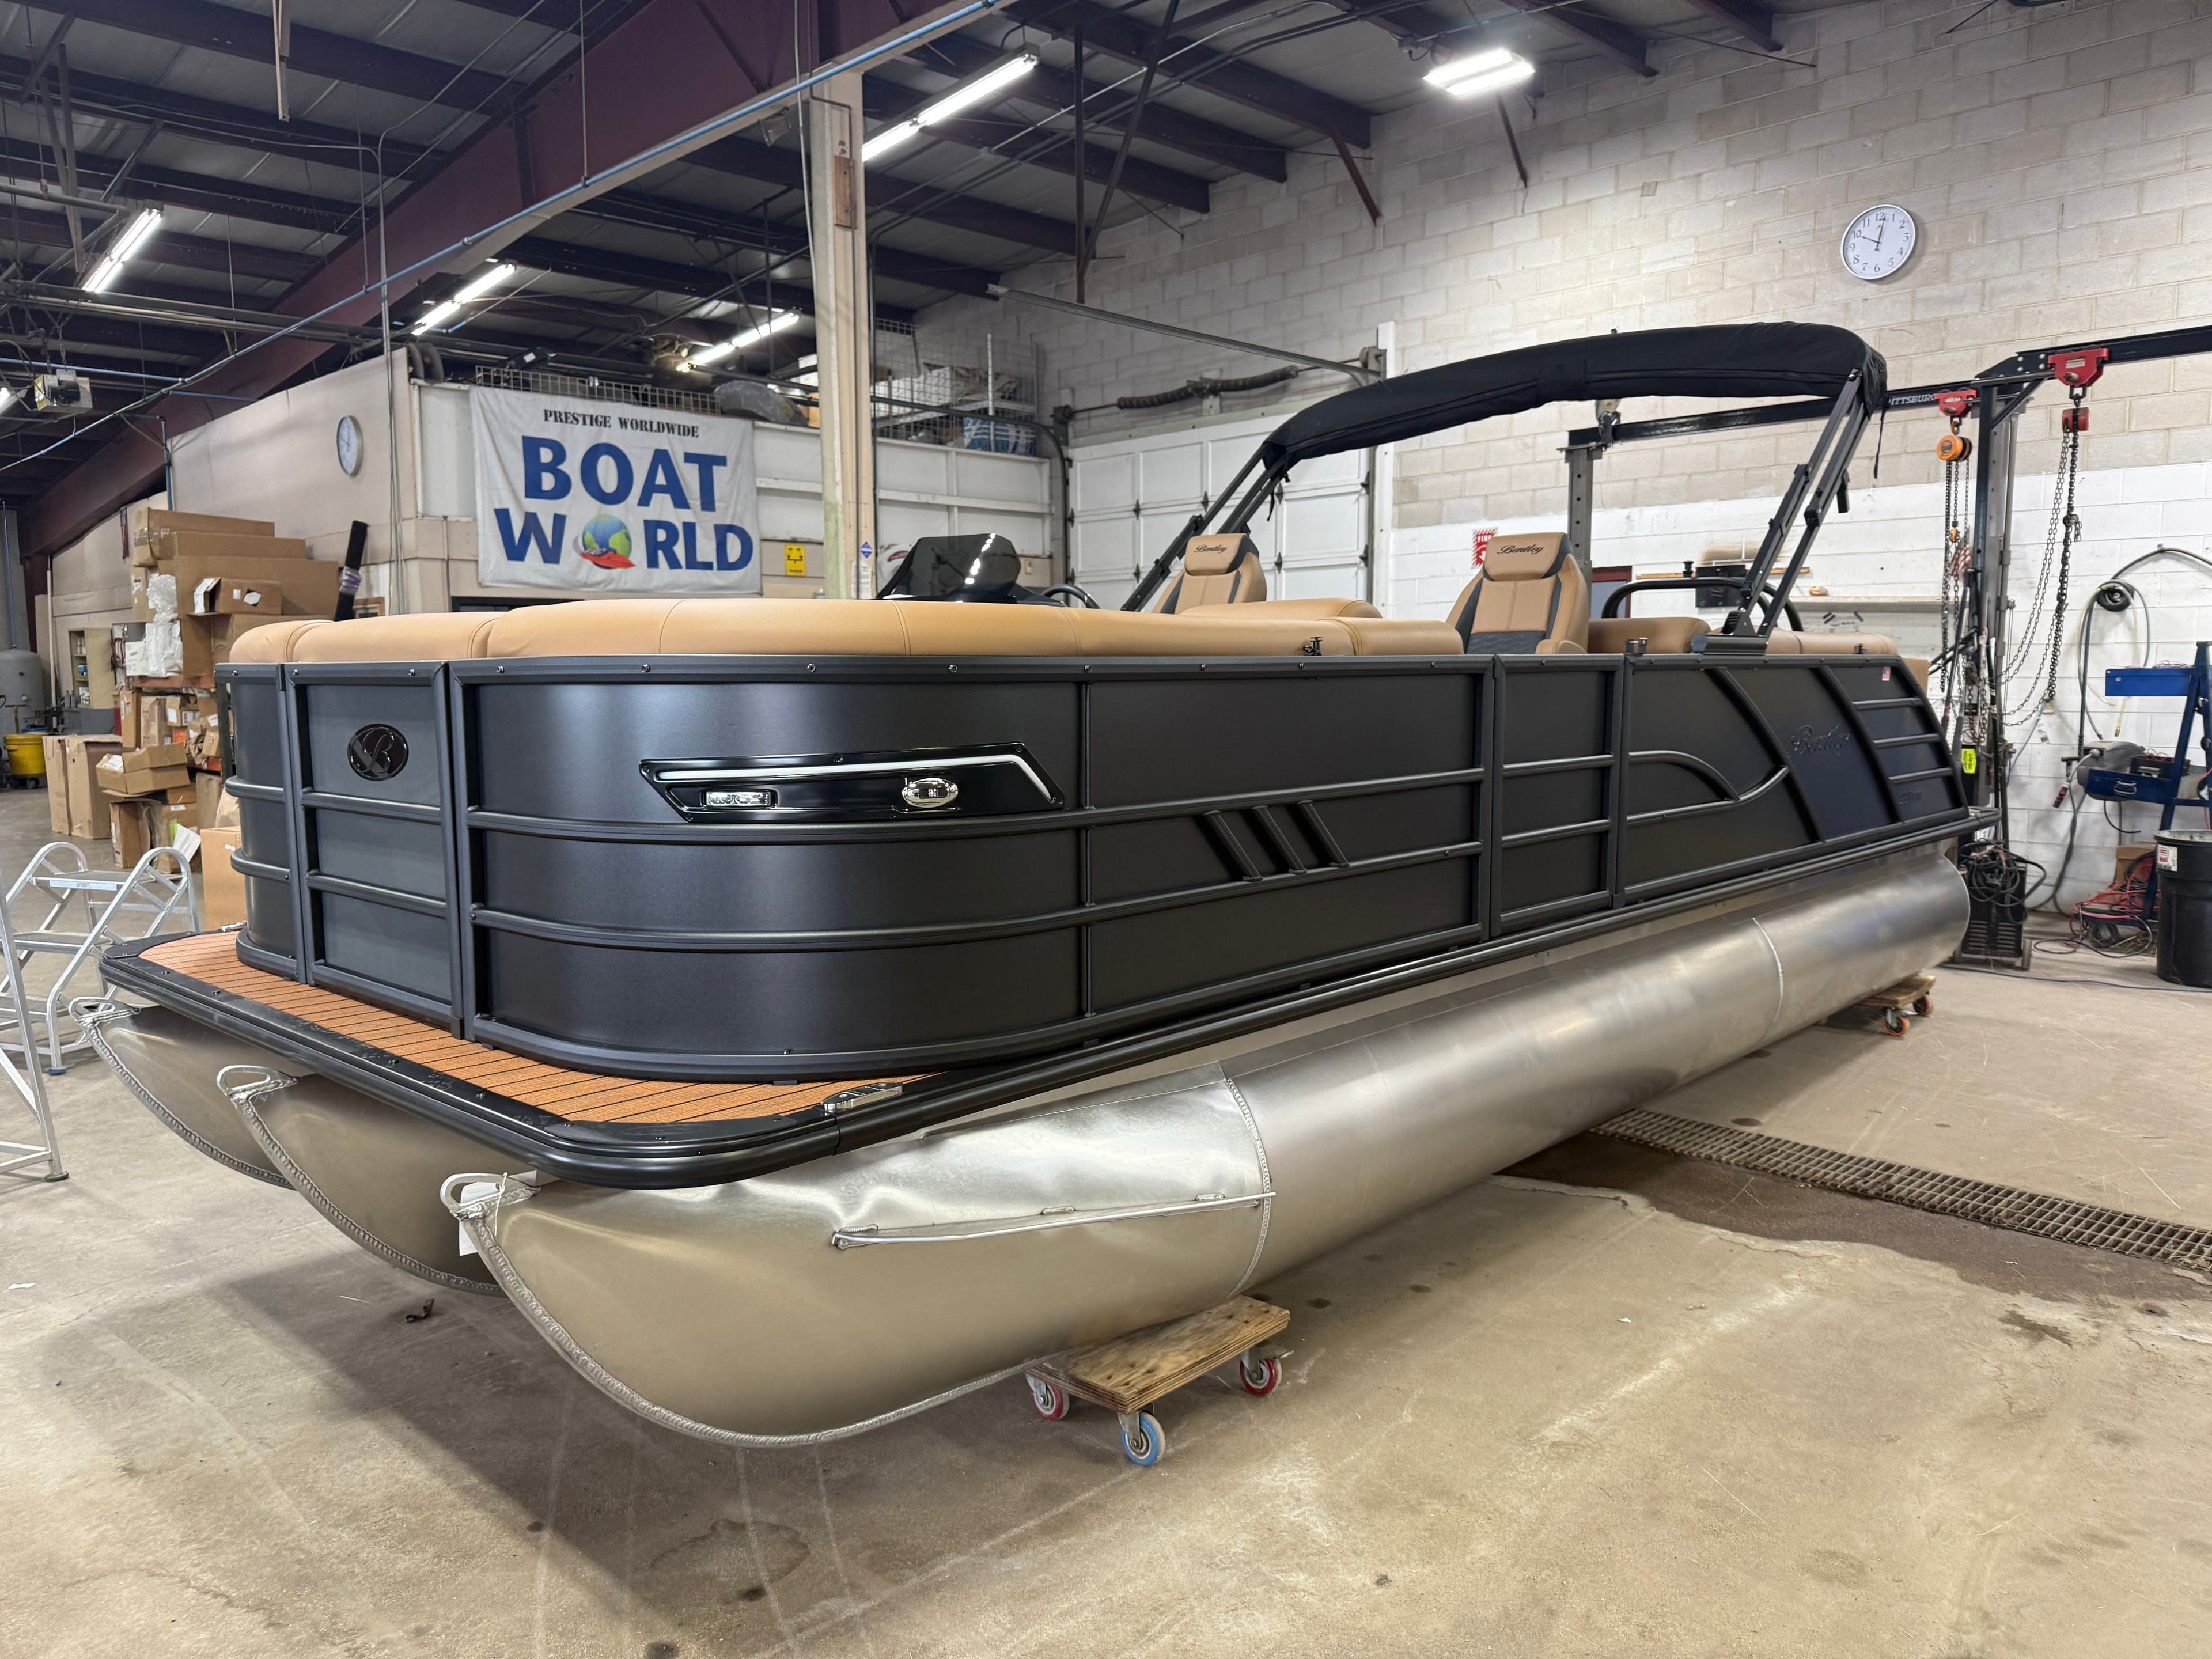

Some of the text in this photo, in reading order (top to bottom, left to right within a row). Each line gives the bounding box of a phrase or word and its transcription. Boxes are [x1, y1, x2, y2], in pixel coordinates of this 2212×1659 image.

[1876, 212, 1885, 221] 12
[1892, 214, 1895, 222] 1
[1863, 219, 1870, 228] 11
[1899, 220, 1906, 229] 2
[1853, 230, 1862, 238] 10
[1903, 233, 1909, 242] 3
[1850, 243, 1855, 251] 9
[1897, 247, 1903, 255] 4
[1853, 255, 1859, 264] 8
[1888, 258, 1894, 267] 5
[1862, 263, 1868, 271] 7
[1874, 264, 1880, 272] 6
[544, 409, 699, 438] PRESTIGE WORLDWIDE
[522, 435, 727, 512] BOAT
[1194, 544, 1228, 553] Bentley
[1497, 544, 1544, 554] Bentley
